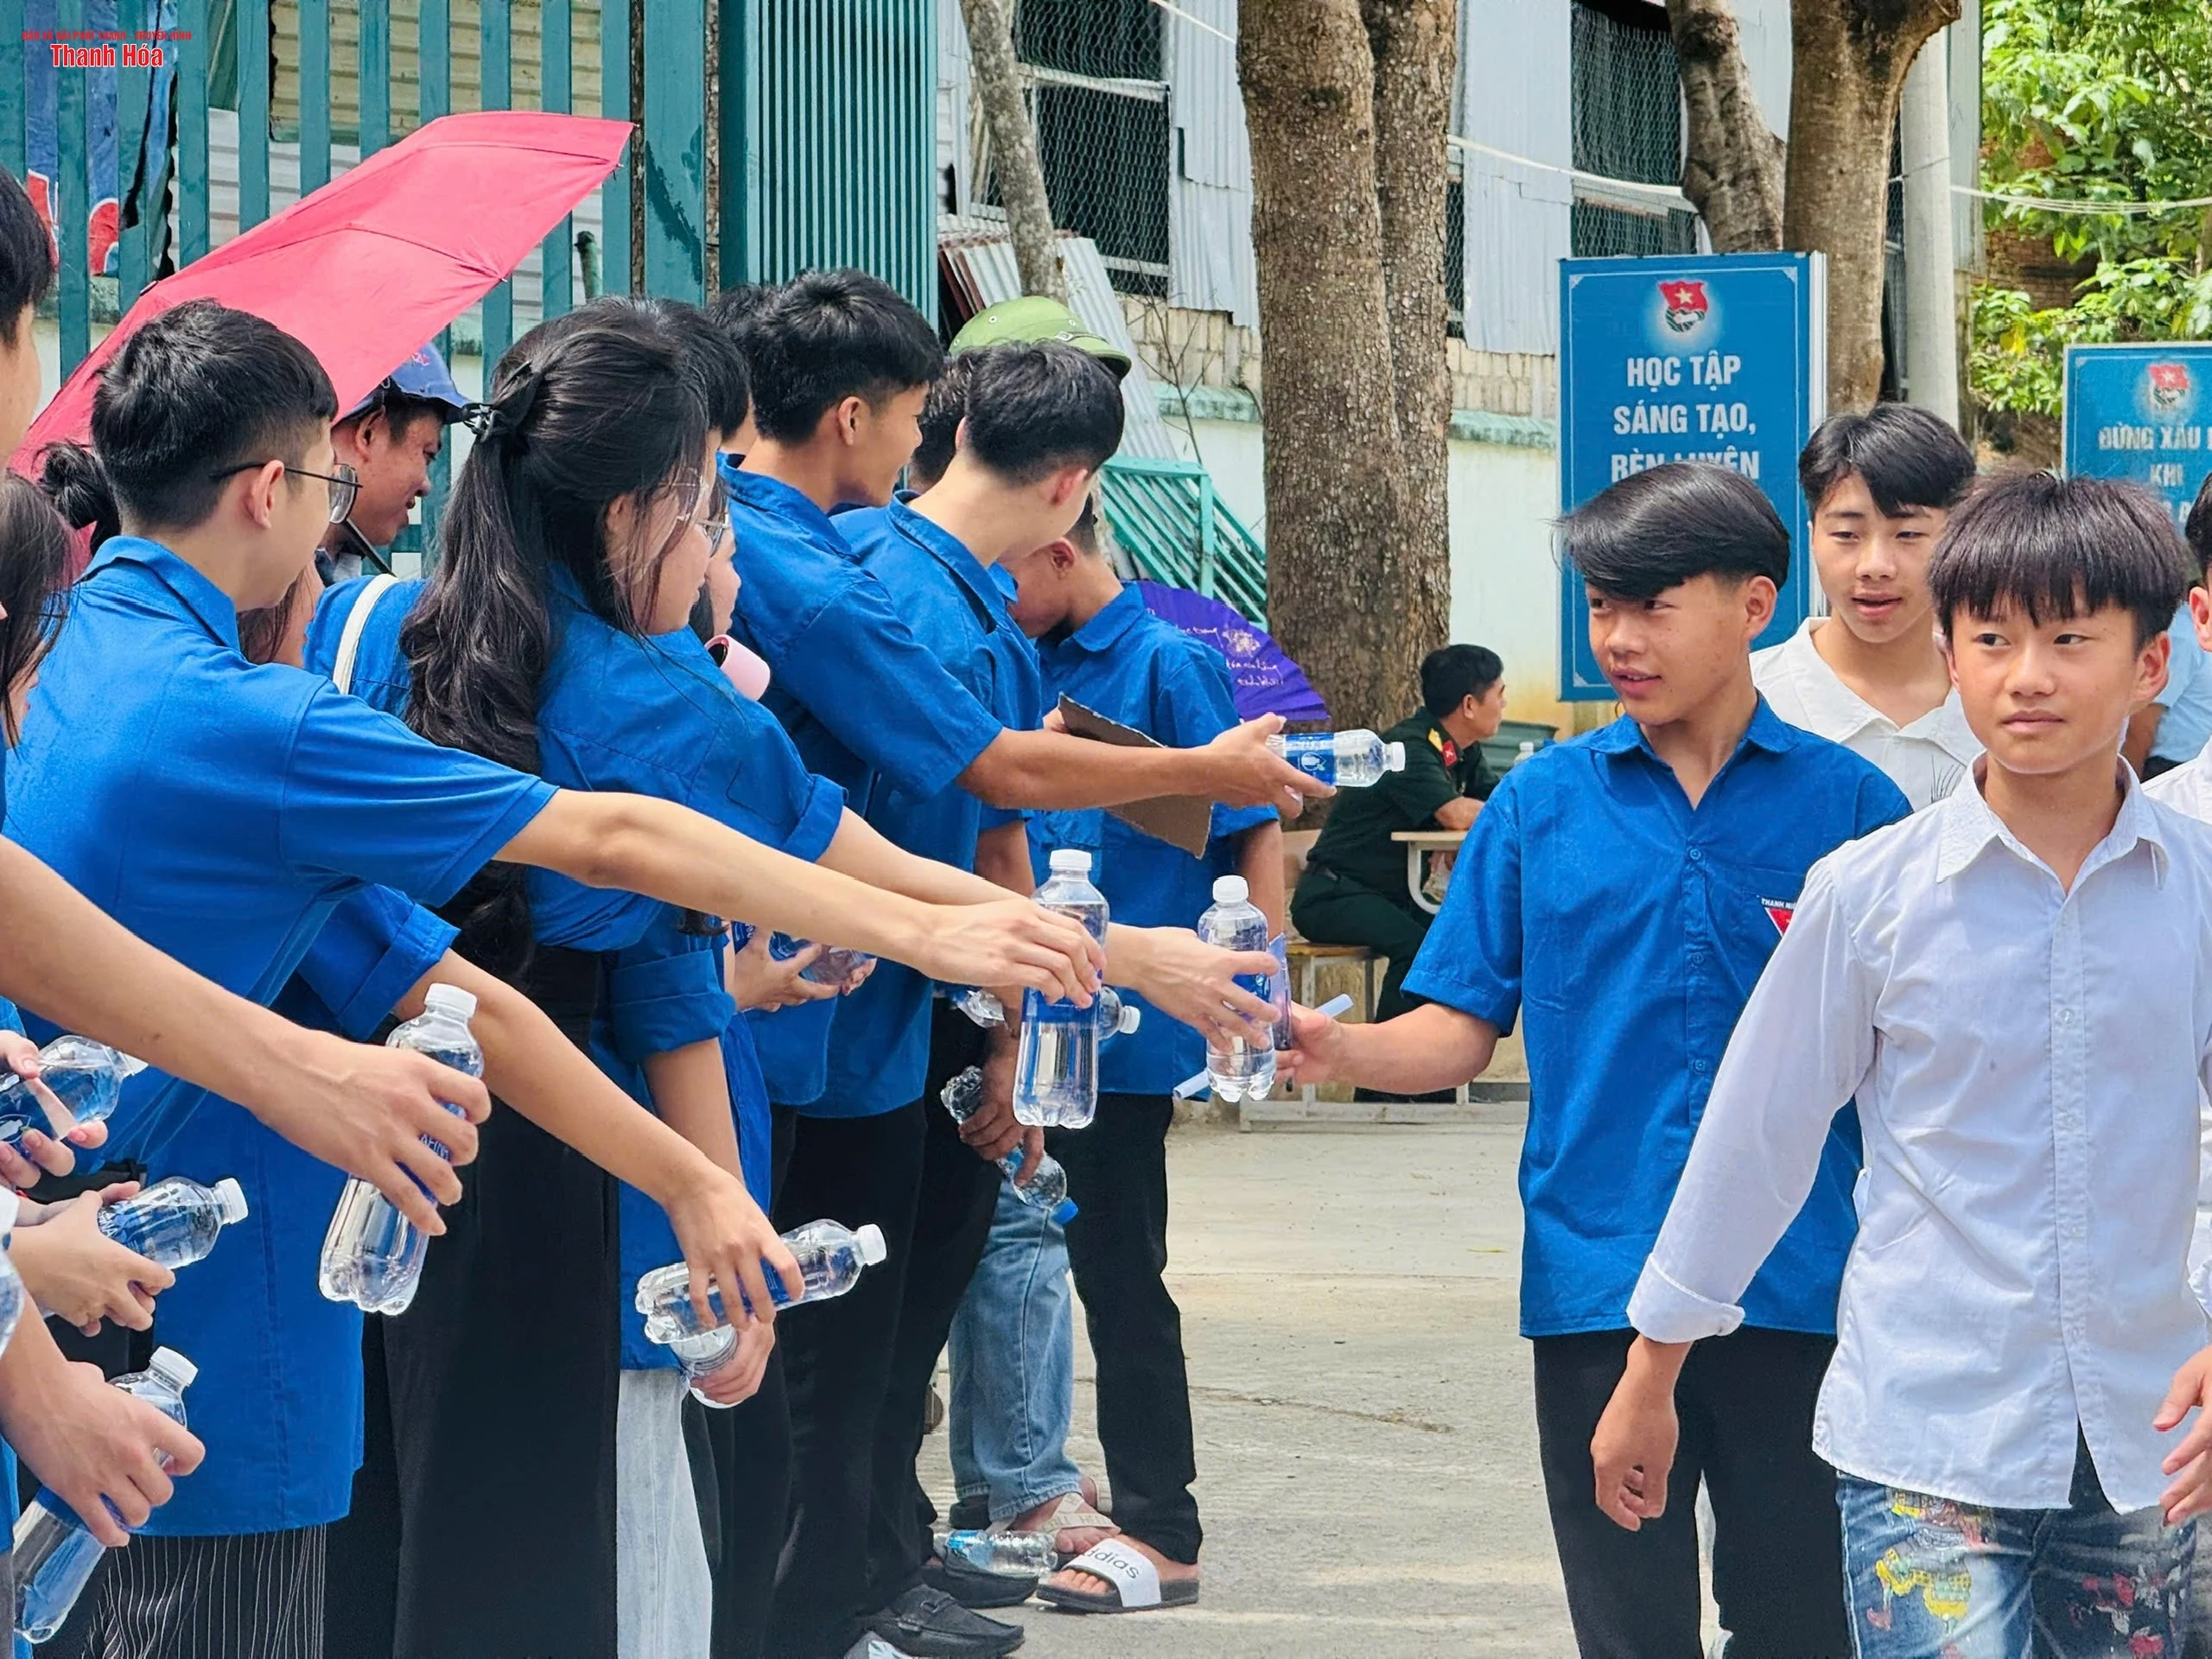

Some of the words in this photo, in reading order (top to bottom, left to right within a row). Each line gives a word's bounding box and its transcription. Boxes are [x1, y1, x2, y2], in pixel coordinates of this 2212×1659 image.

[1627, 356, 1681, 392] HỌC
[1689, 350, 1741, 391] TẬP
[1613, 399, 1688, 435] SÁNG
[1695, 403, 1757, 439] TẠO,
[2098, 422, 2153, 450] ĐỪNG
[2150, 464, 2183, 487] KHI
